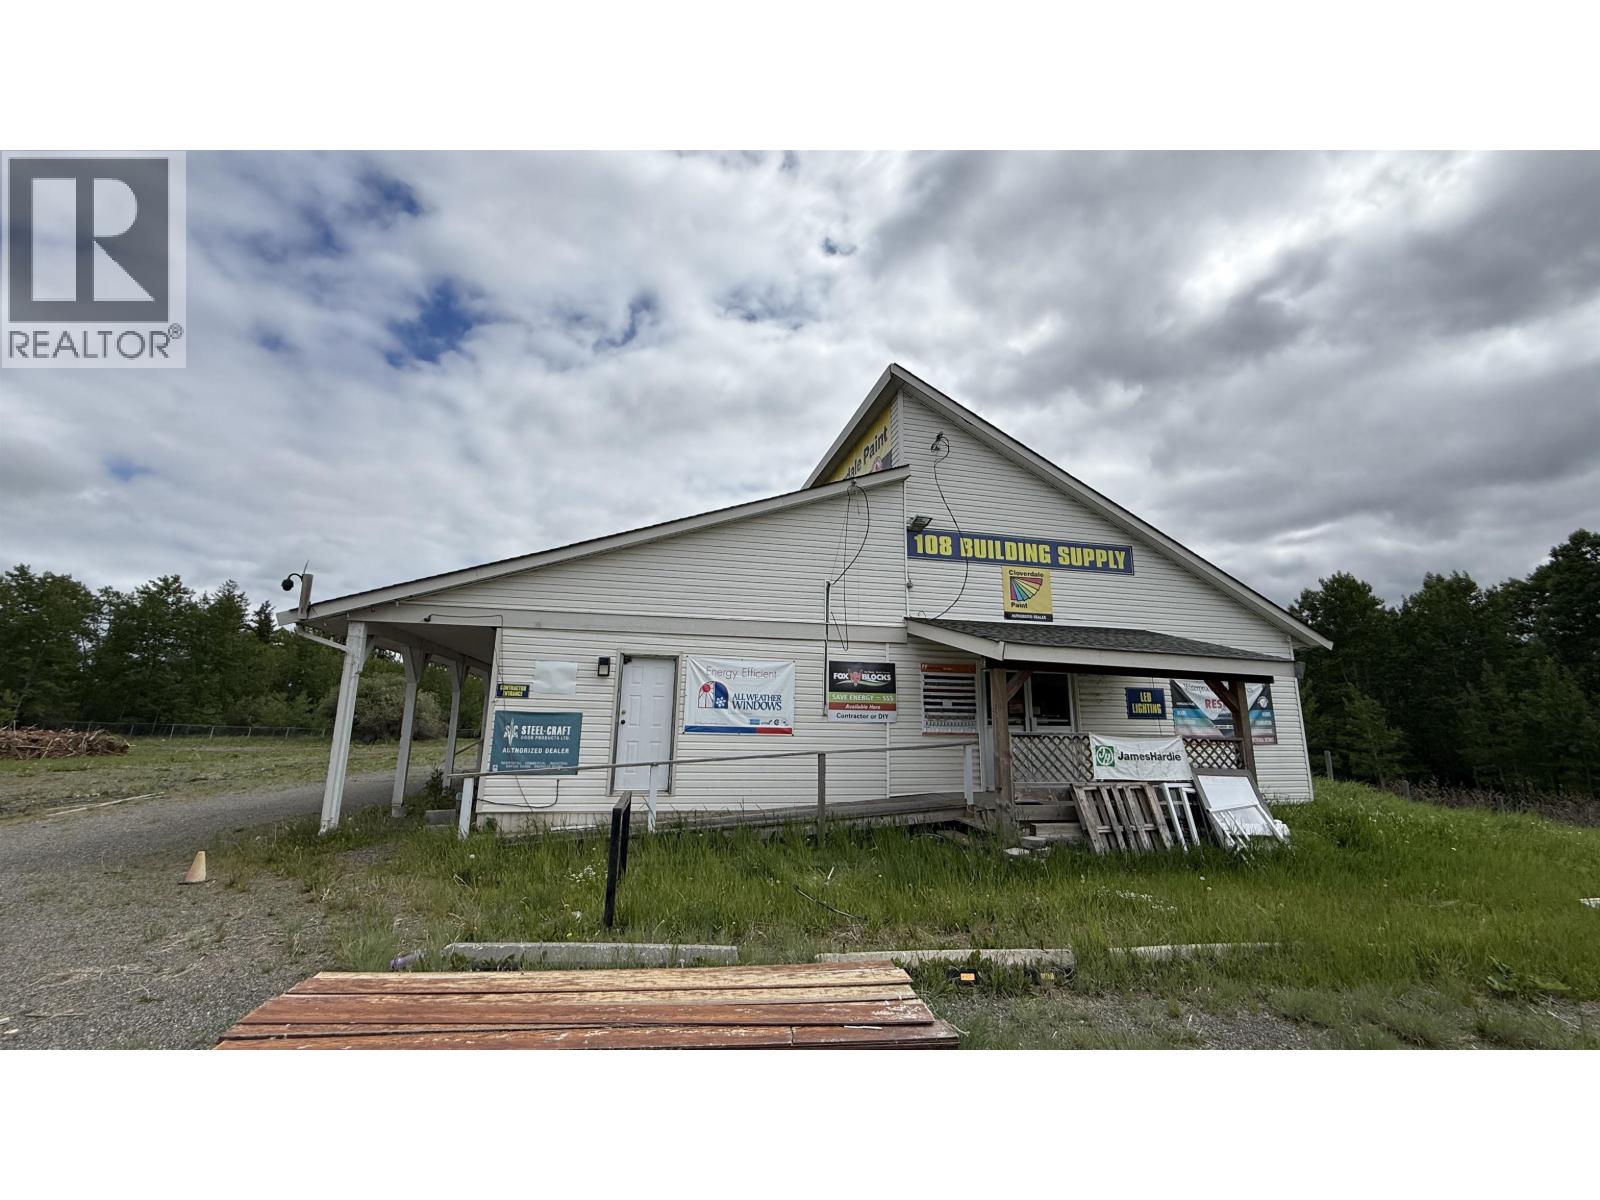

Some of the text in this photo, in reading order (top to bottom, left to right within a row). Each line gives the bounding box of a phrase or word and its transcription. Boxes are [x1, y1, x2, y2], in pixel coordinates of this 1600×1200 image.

[863, 426, 888, 465] Paint
[914, 534, 1125, 569] 108 BUILDING SUPPLY
[1008, 569, 1044, 577] Cloverdale
[706, 666, 777, 679] Energy Efficient
[833, 672, 849, 680] FOX
[746, 693, 782, 702] WEATHER
[1140, 691, 1152, 702] LED
[732, 700, 782, 711] WINDOWS
[1131, 703, 1162, 714] LIGHTING
[521, 725, 571, 735] STEEL-CRAFT
[1117, 751, 1182, 761] JamesHardie
